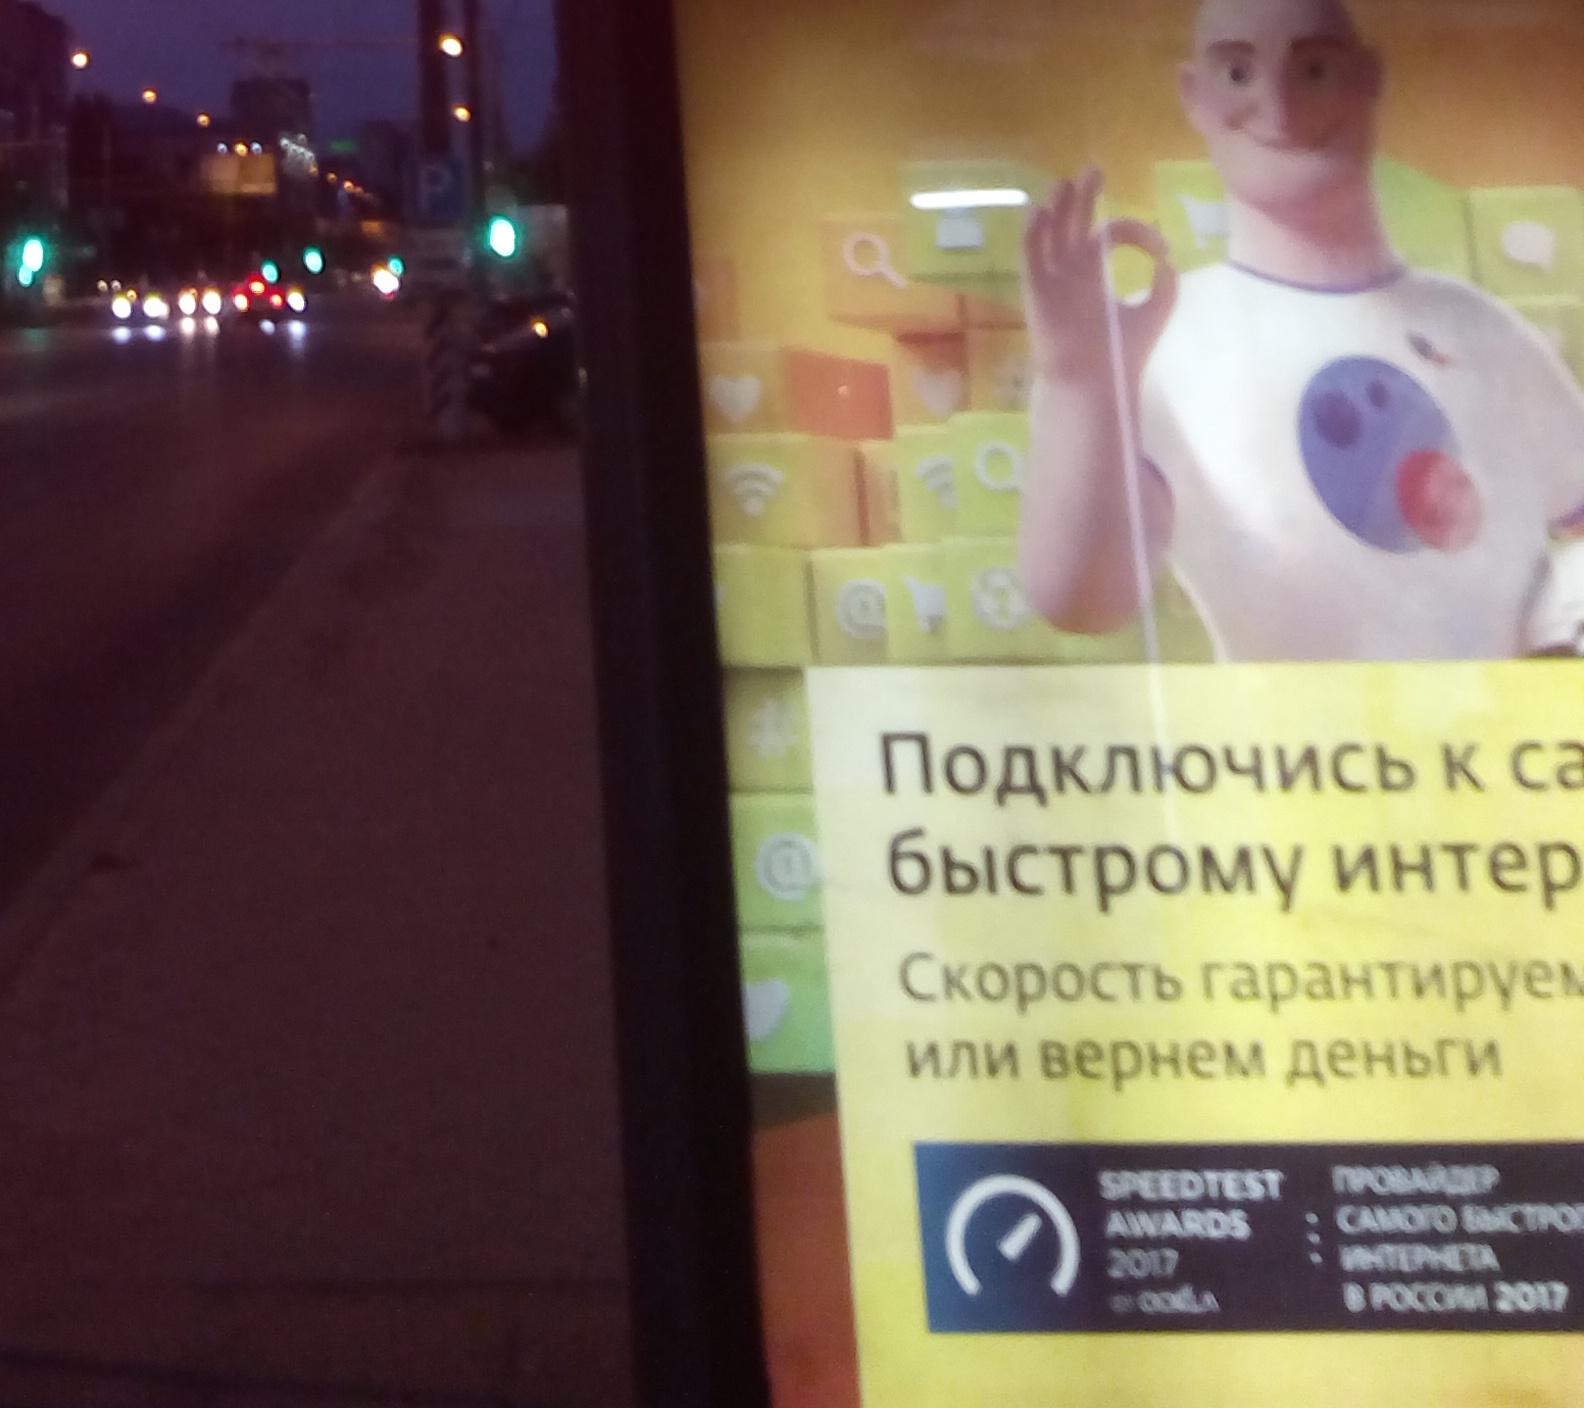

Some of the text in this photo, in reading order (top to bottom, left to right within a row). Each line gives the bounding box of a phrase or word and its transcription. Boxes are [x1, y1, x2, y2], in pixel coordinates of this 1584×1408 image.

[880, 730, 1418, 807] Подключись
[1440, 741, 1485, 792] к
[887, 826, 1584, 914] быстрому интер
[899, 950, 1184, 1016] Скорость
[906, 1032, 1504, 1092] или вернем деньги
[1099, 1168, 1285, 1202] SPEEDTEST
[1106, 1207, 1252, 1240] AWARDS
[1336, 1204, 1459, 1234] САМОГО
[1107, 1247, 1180, 1279] 2017
[1369, 1281, 1490, 1313] РОССИИ
[1494, 1280, 1569, 1313] 2017
